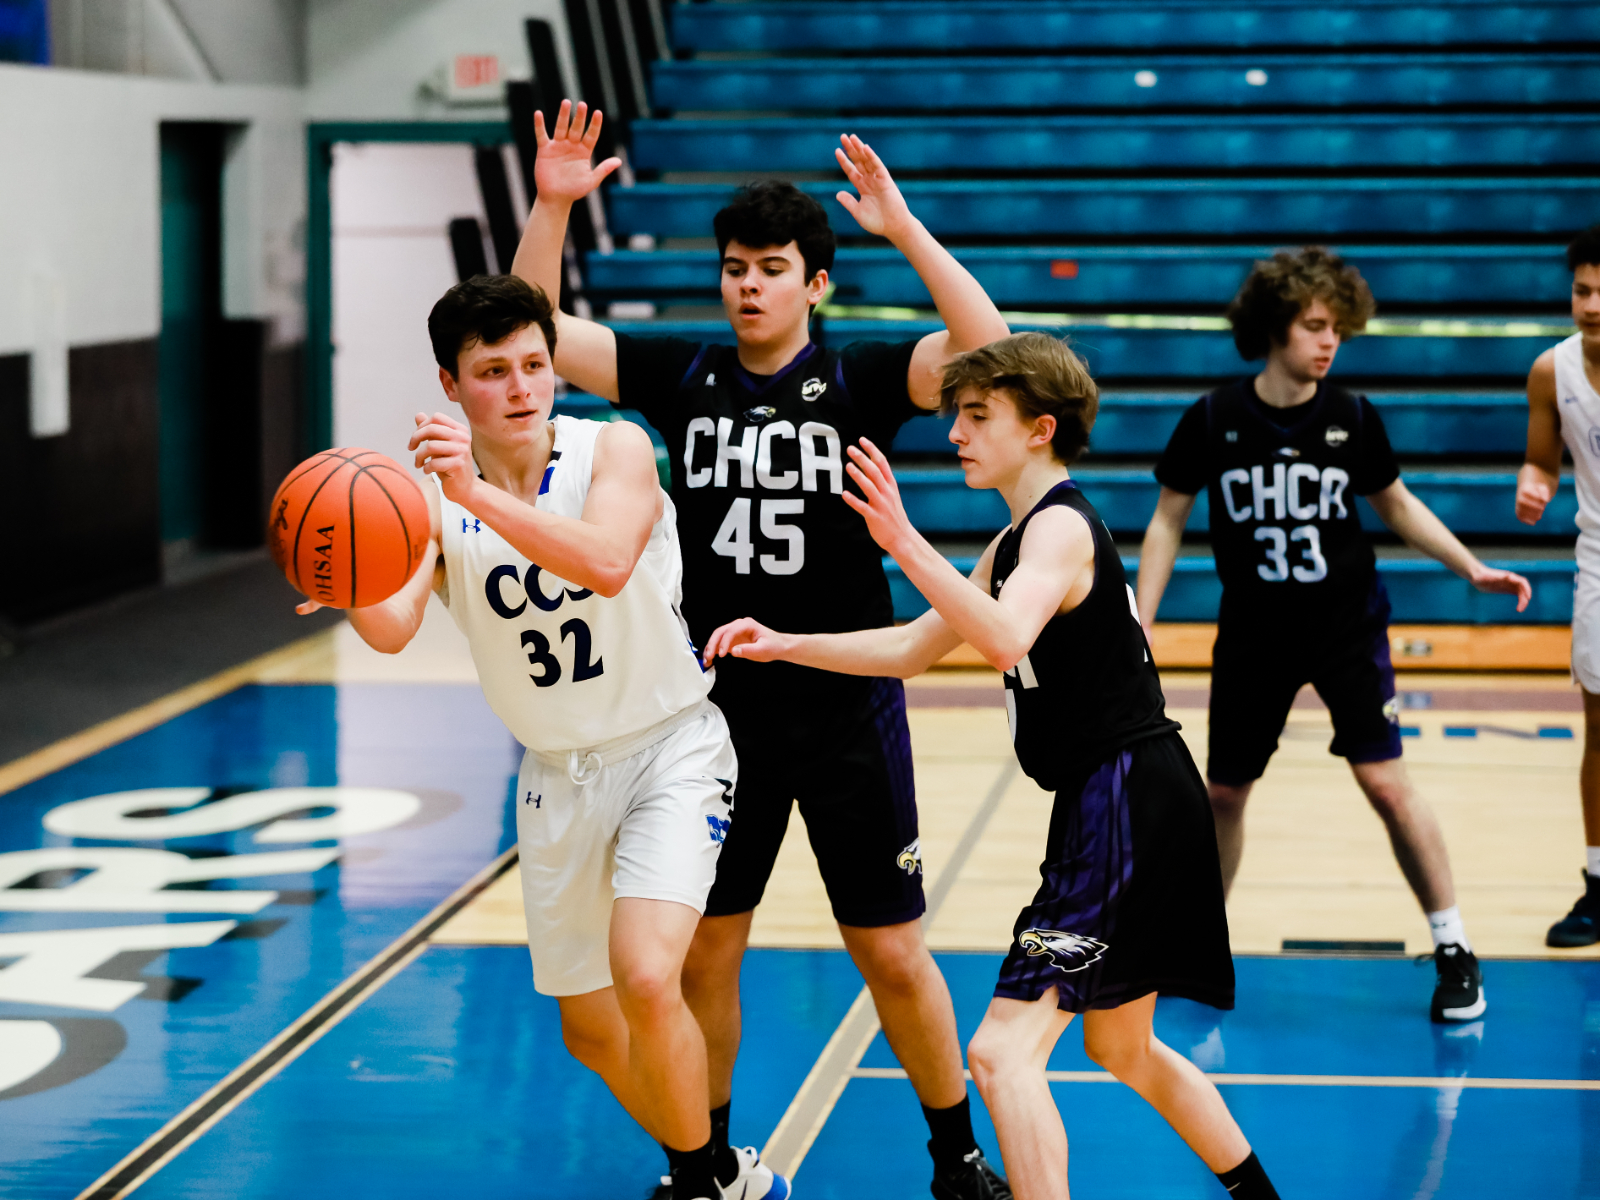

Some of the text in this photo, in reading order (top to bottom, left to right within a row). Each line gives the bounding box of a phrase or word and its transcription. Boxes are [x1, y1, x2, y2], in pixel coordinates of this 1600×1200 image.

[684, 417, 843, 494] CHCA
[1220, 462, 1349, 523] CHCA
[313, 524, 336, 602] OHSAA
[711, 497, 804, 575] 45
[1254, 524, 1328, 583] 33
[520, 618, 604, 687] 32
